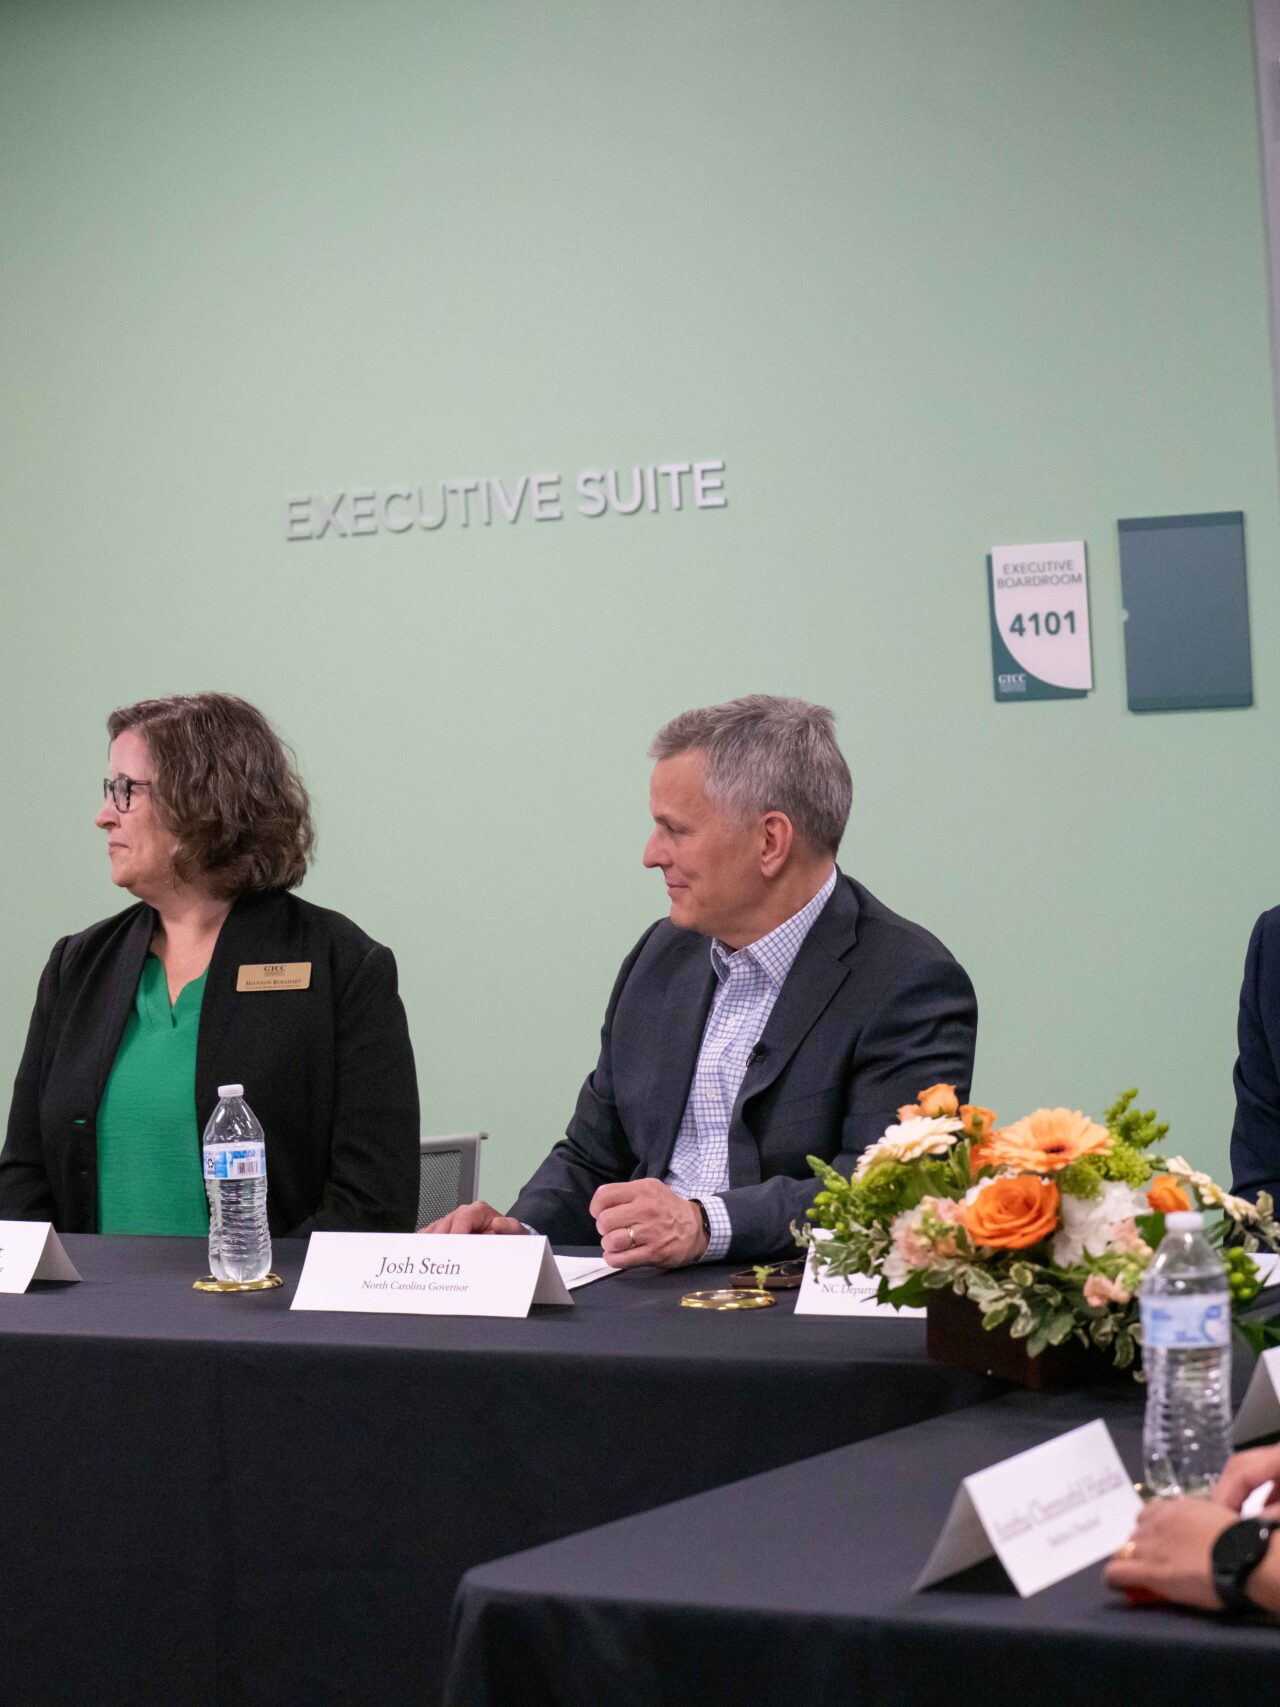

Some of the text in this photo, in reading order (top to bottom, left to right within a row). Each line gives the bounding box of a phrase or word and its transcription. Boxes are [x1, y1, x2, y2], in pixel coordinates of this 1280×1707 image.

[286, 460, 728, 542] EXECUTIVE SUITE
[1002, 559, 1075, 575] EXECUTIVE
[996, 573, 1083, 589] BOARDROOM
[1009, 610, 1077, 637] 4101
[375, 1256, 461, 1278] Josh Stein
[360, 1279, 470, 1292] North Carolina Governor
[821, 1283, 838, 1295] NC
